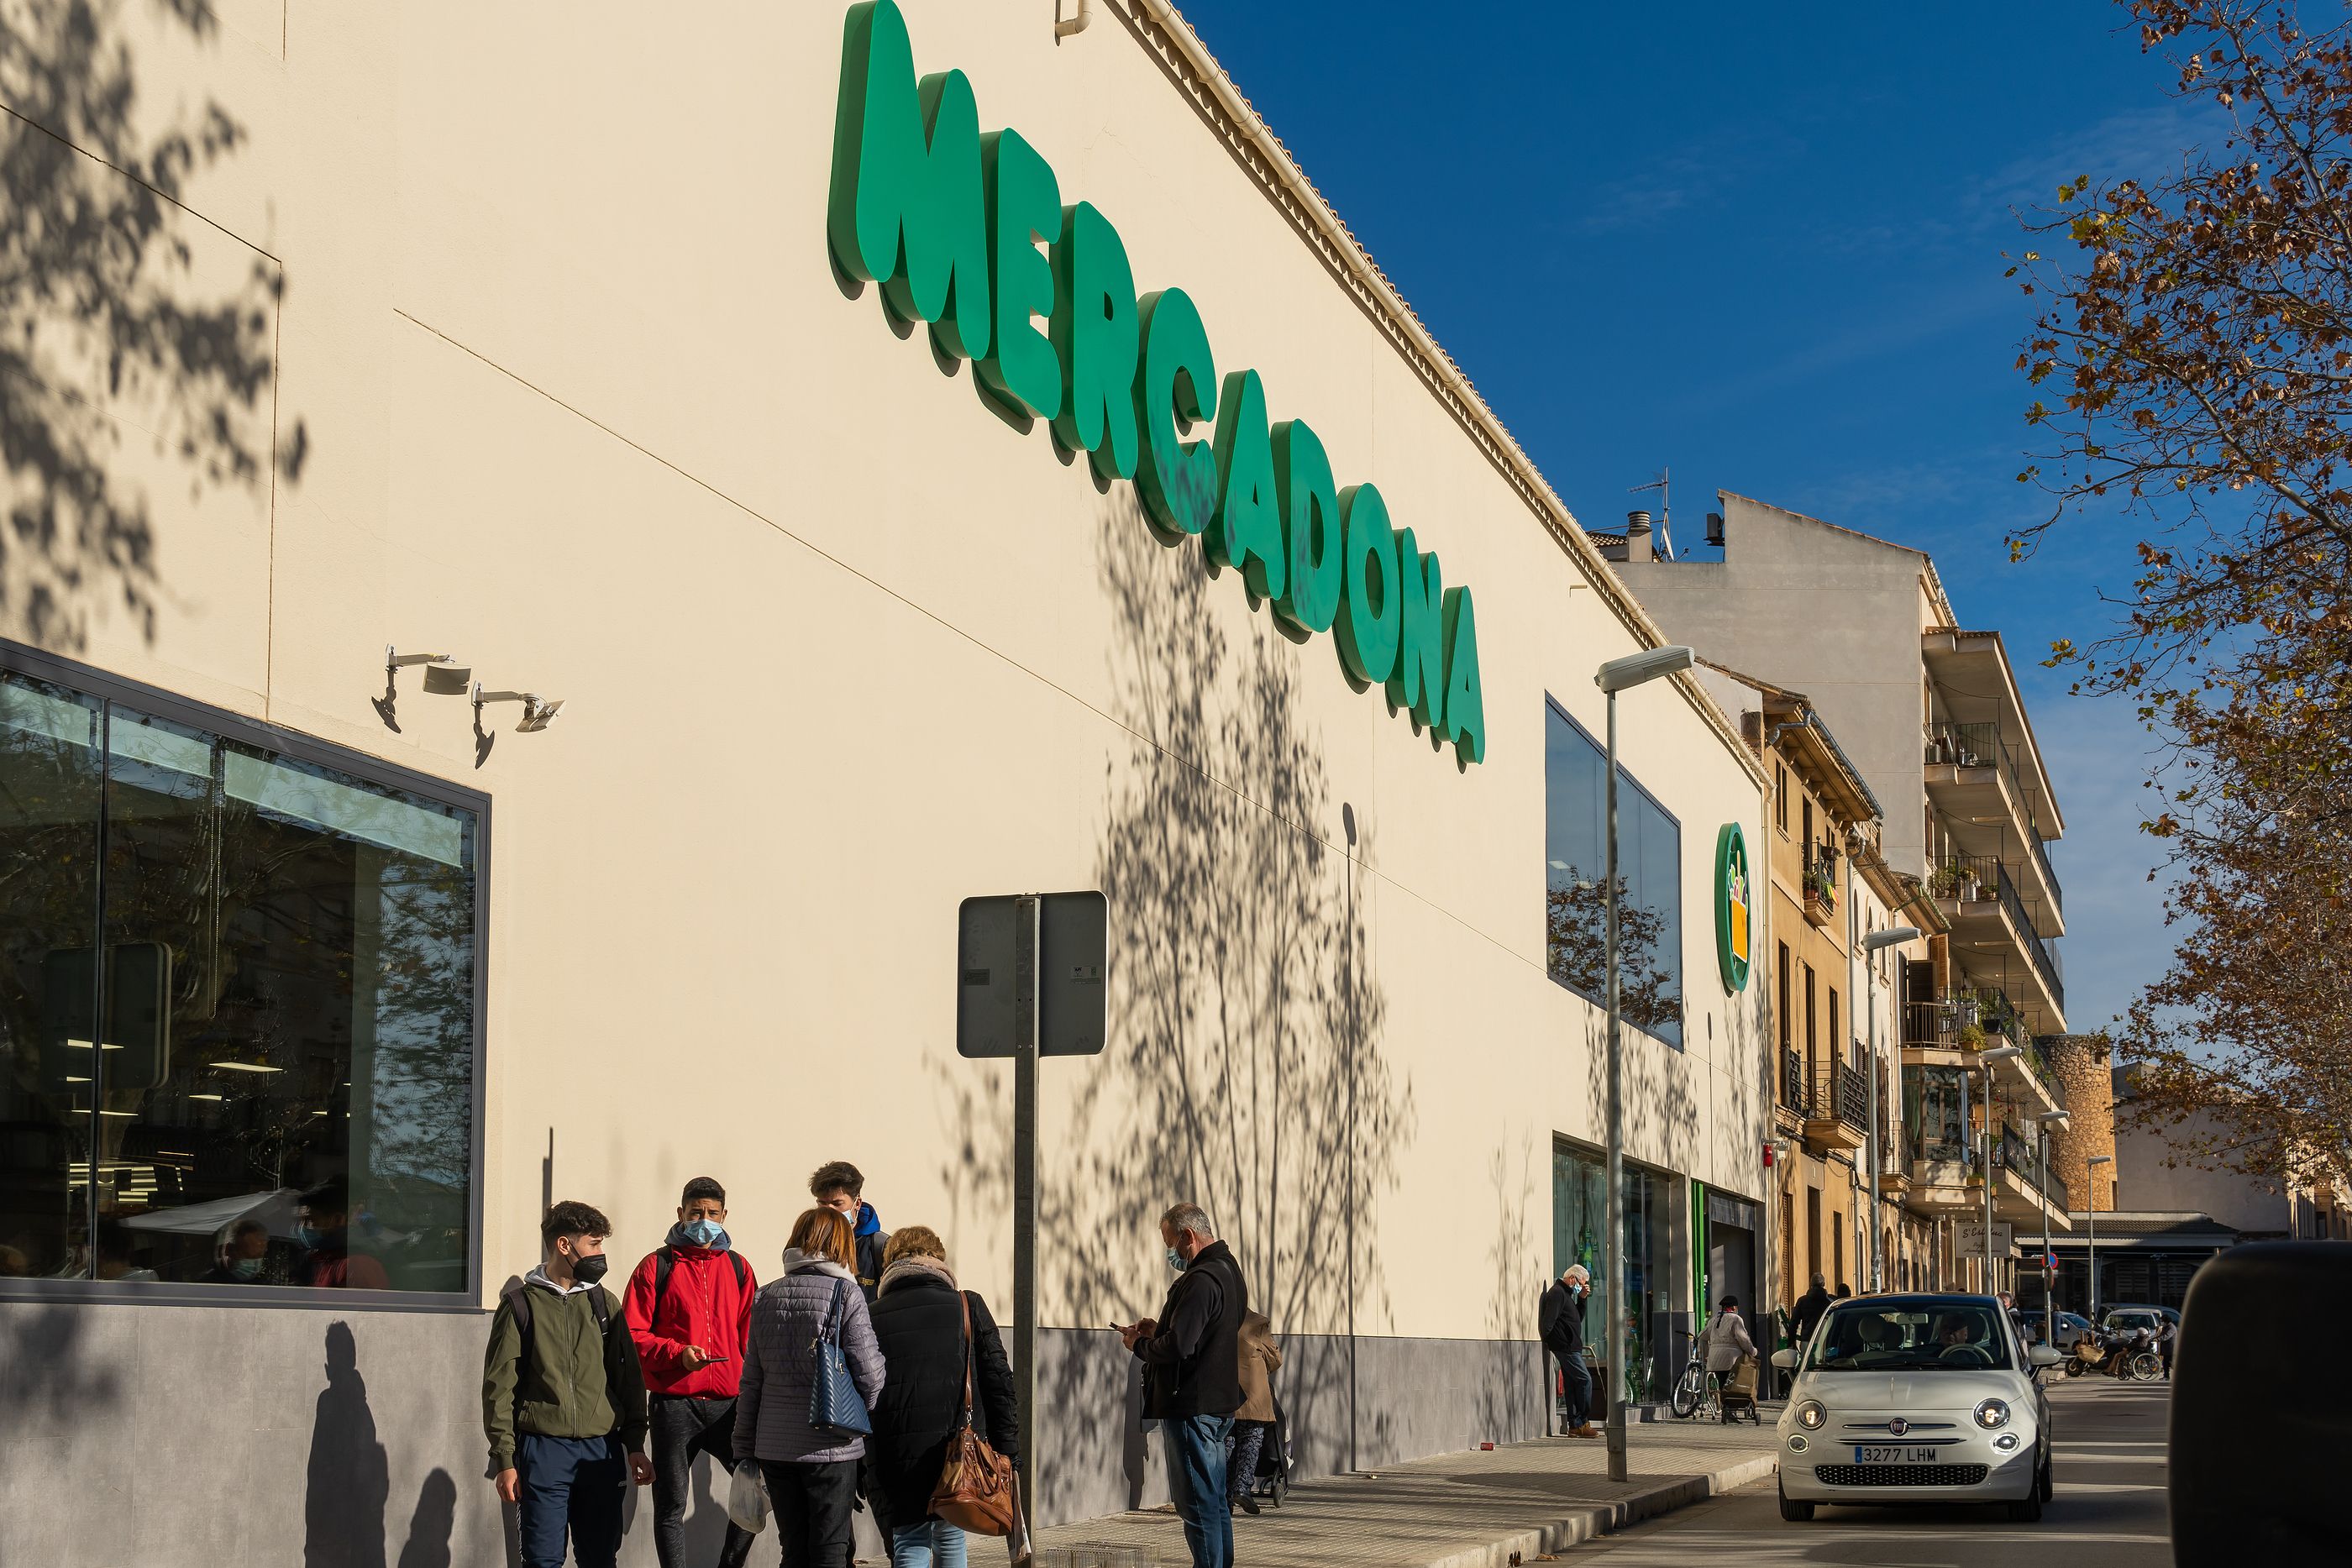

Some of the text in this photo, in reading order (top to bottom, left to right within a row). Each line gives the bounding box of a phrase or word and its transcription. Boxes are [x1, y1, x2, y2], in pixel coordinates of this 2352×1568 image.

[827, 0, 1485, 766] MERCADONA
[1962, 1227, 2003, 1239] S'Esttua
[1864, 1448, 1936, 1461] 3277 LHM
